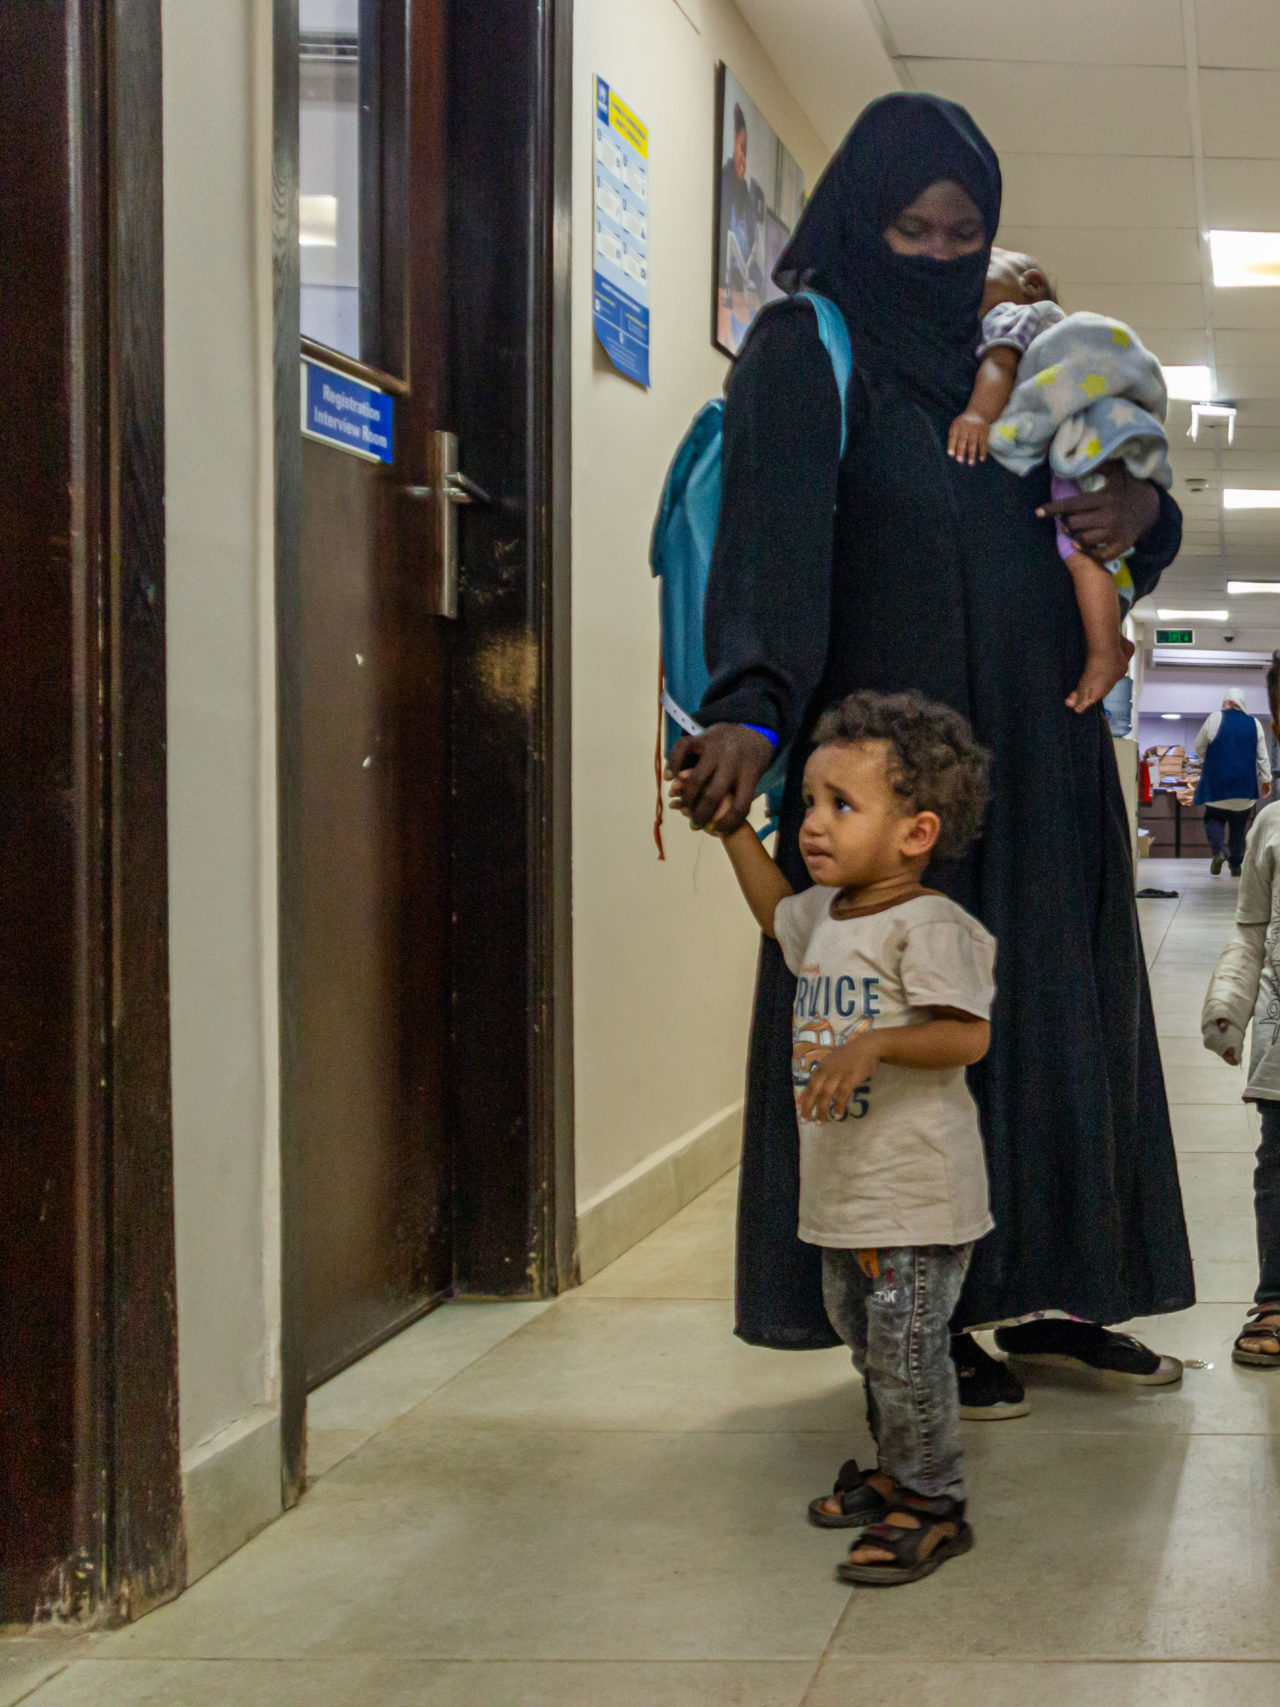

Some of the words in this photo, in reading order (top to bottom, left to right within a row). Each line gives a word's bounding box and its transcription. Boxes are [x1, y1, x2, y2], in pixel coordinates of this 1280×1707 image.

[322, 383, 381, 422] Registration
[313, 405, 360, 438] Interview
[362, 424, 388, 449] Room
